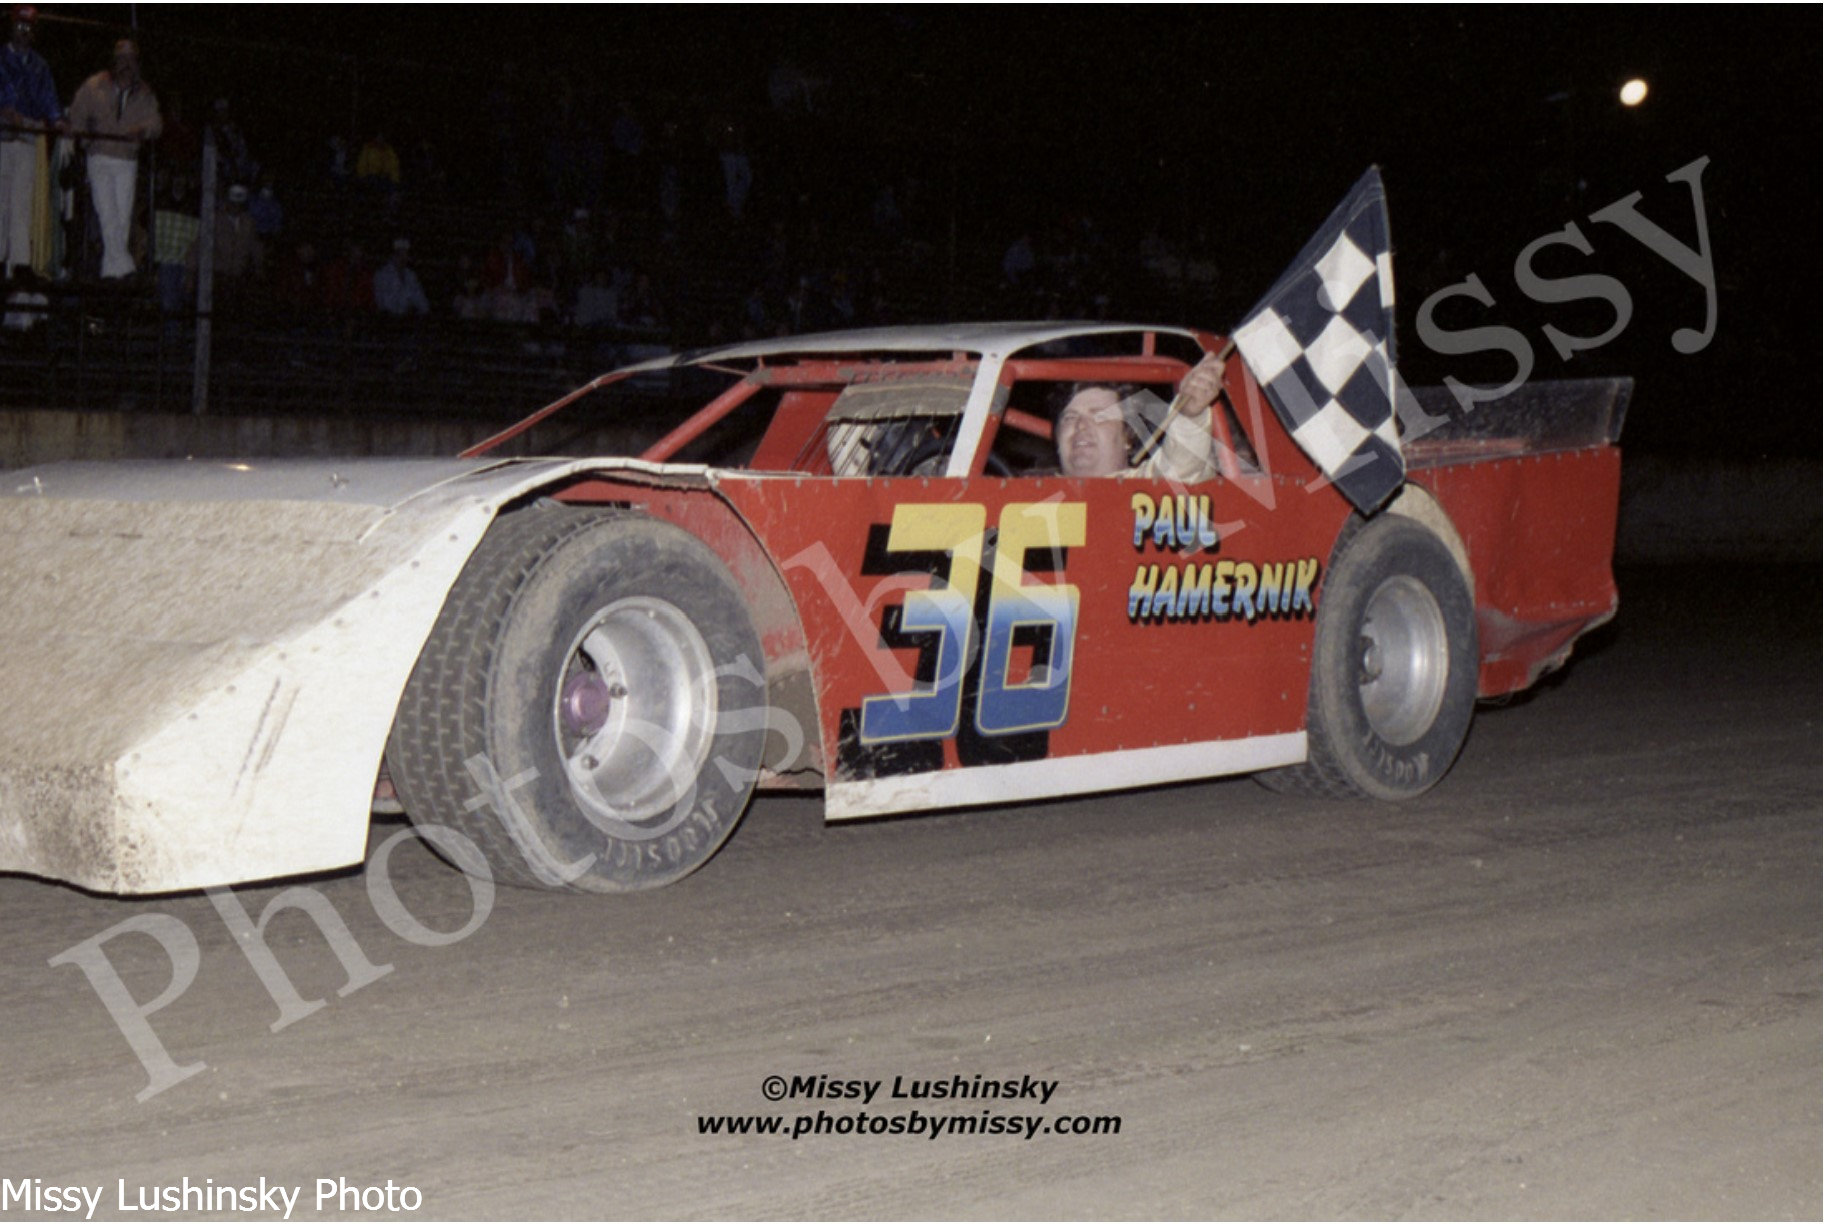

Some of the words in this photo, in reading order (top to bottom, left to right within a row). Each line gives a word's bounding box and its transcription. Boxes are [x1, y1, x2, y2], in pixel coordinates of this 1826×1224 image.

[1131, 492, 1218, 550] PAUL
[1128, 557, 1319, 622] HAMERNIK
[860, 502, 1088, 744] 36
